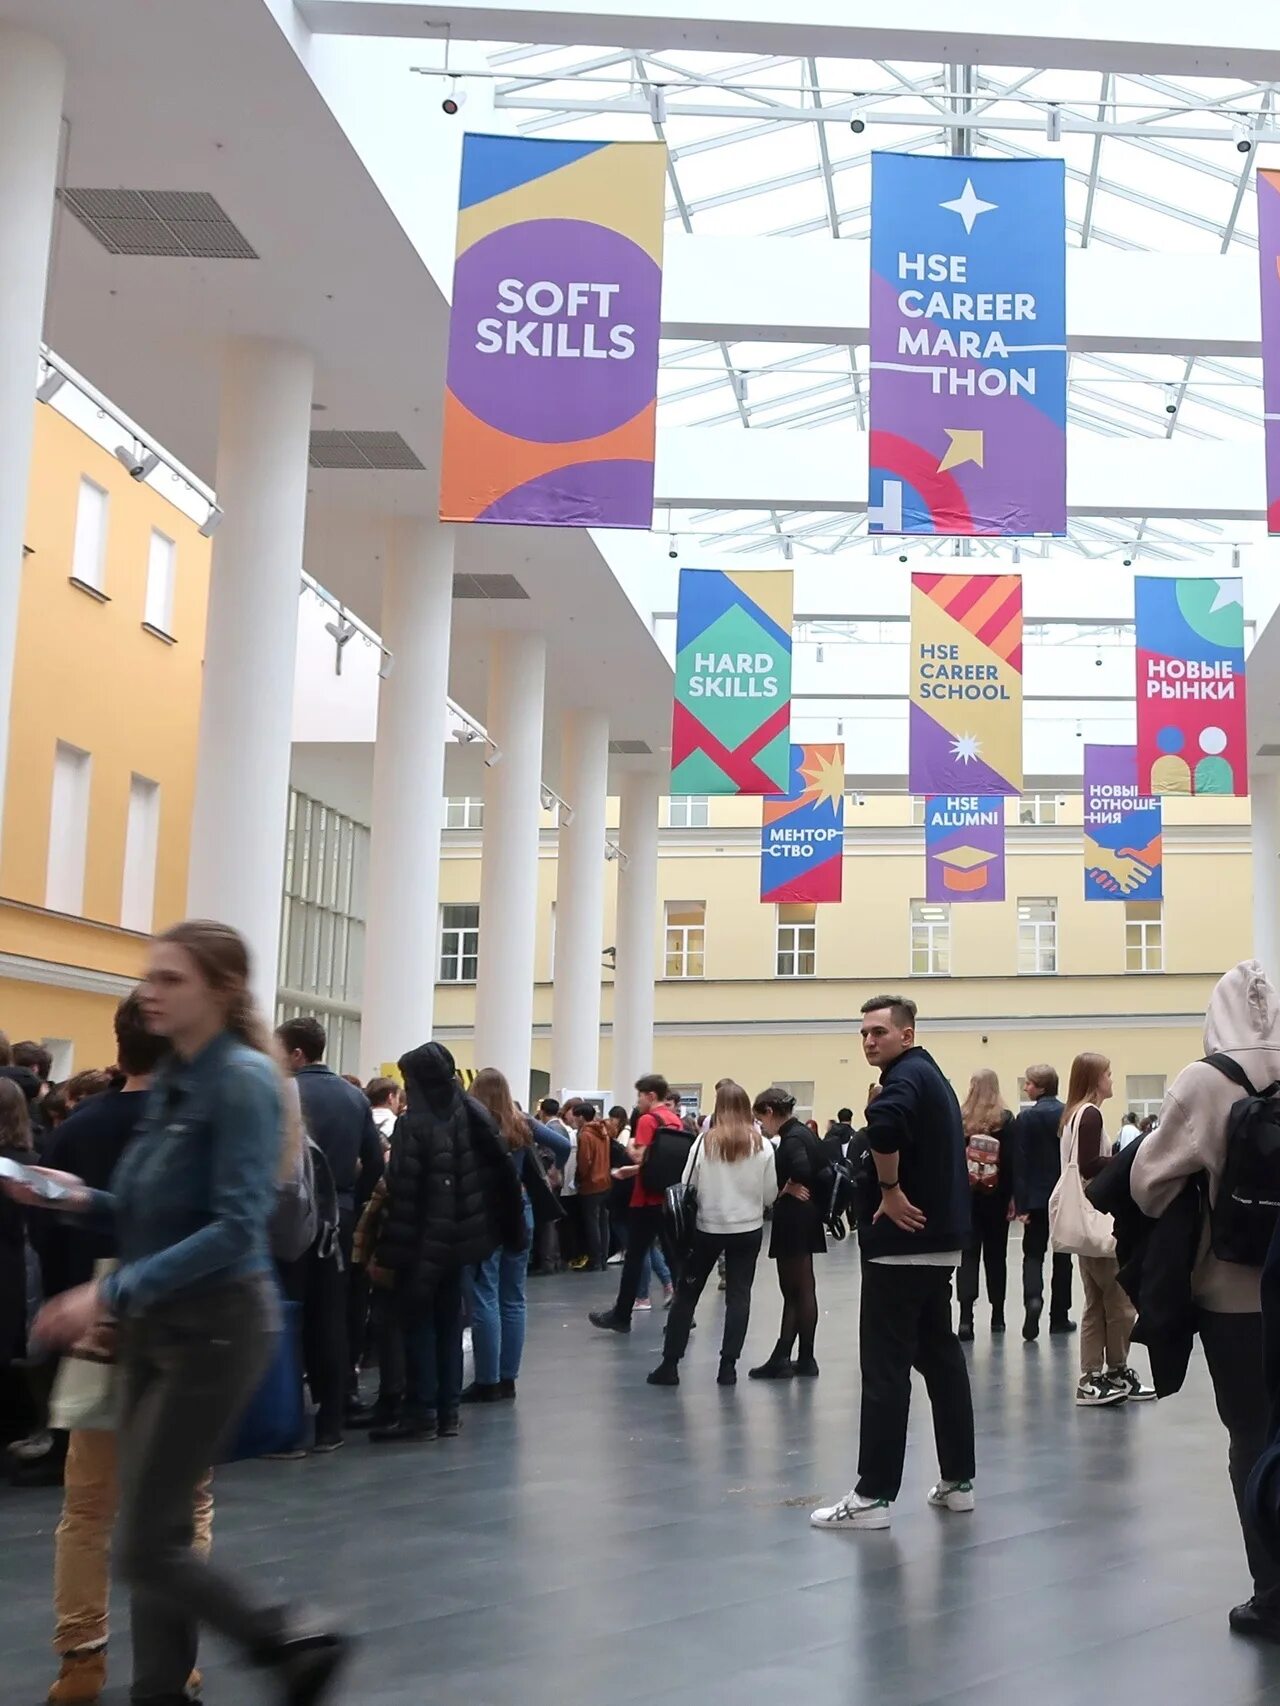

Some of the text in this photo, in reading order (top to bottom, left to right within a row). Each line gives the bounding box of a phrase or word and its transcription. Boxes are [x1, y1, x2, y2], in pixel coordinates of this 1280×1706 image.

[898, 251, 967, 283] HSE
[496, 278, 620, 318] SOFT
[898, 289, 1037, 321] CAREER
[475, 318, 635, 360] SKILLS
[920, 643, 959, 660] HSE
[694, 652, 774, 674] HARD
[920, 663, 998, 680] CAREER
[1147, 659, 1233, 679] НОВЫЕ
[688, 675, 778, 698] SKILLS
[920, 682, 1010, 700] SCHOOL
[1146, 679, 1235, 700] РЫНКИ
[946, 796, 979, 811] HSE
[931, 811, 998, 826] ALUMNI
